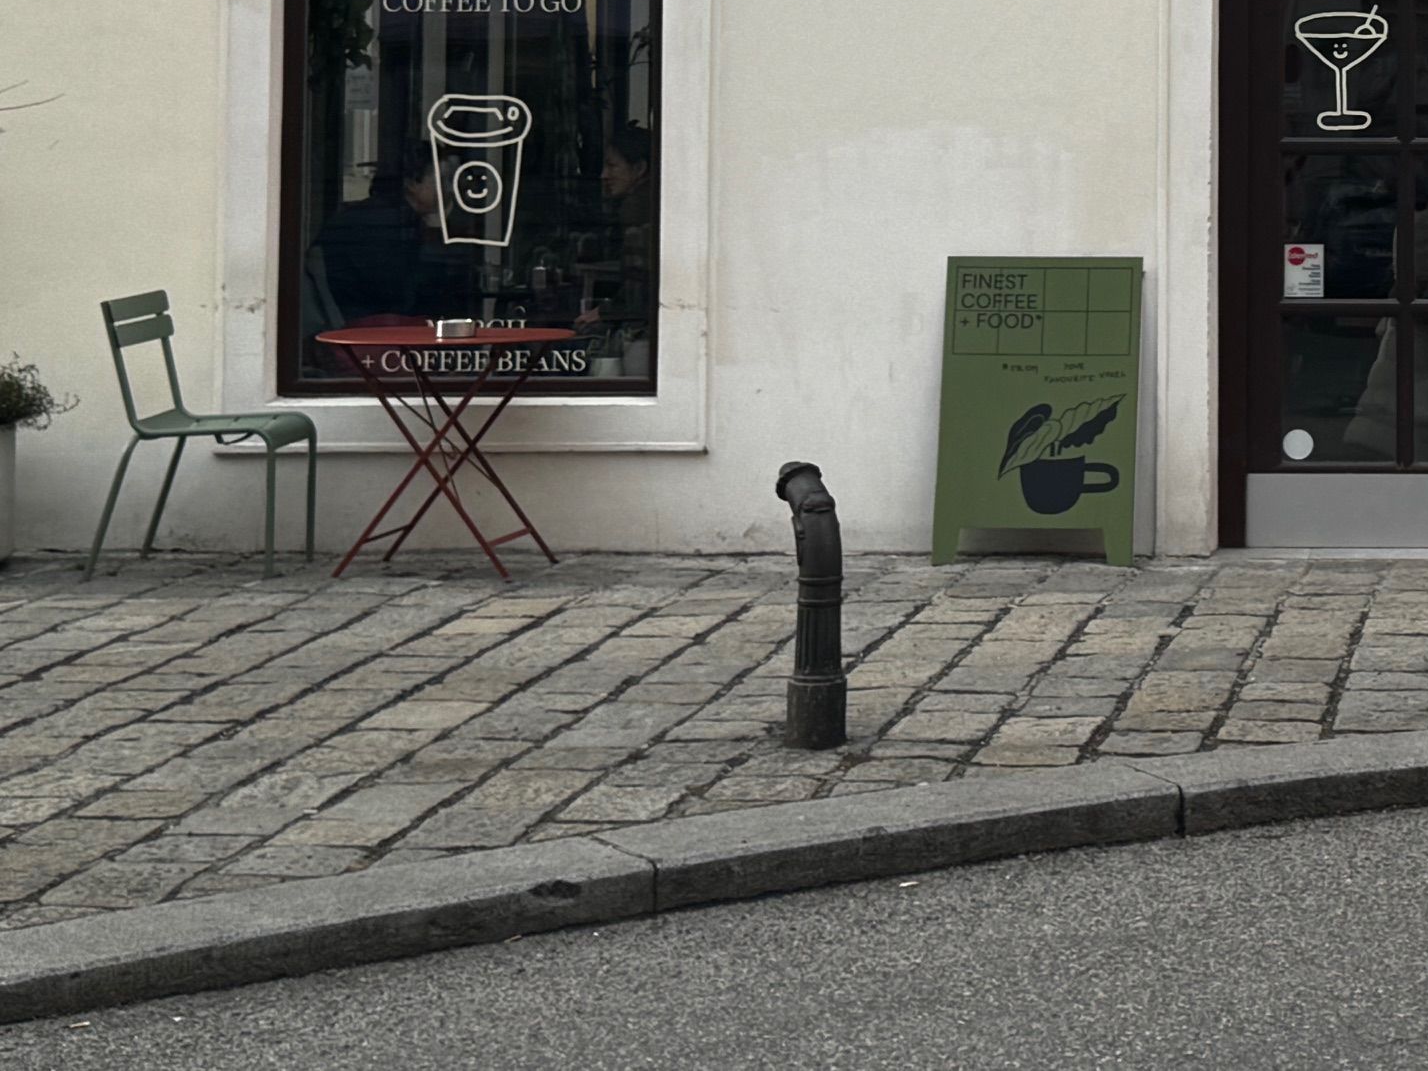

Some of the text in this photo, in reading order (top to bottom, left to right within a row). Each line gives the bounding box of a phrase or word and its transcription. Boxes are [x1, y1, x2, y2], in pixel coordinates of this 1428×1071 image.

[962, 273, 1029, 290] FINEST
[961, 292, 1038, 309] COFFEE
[961, 316, 970, 327] +
[380, 349, 488, 372] COFFEE
